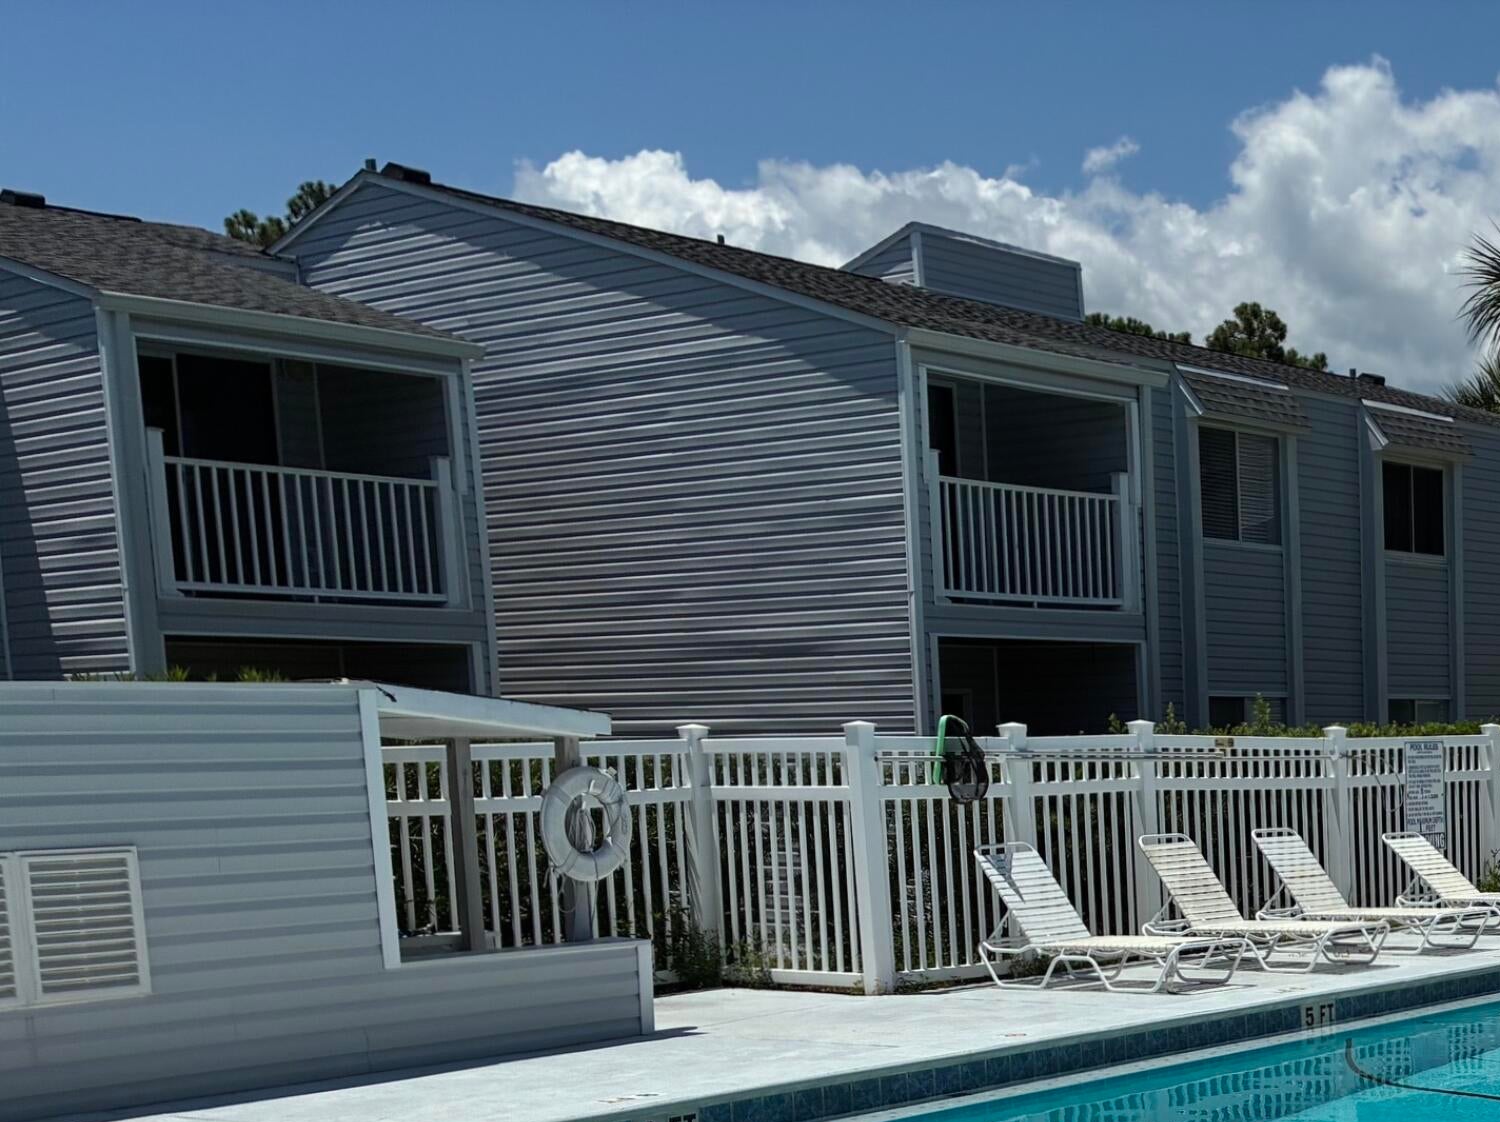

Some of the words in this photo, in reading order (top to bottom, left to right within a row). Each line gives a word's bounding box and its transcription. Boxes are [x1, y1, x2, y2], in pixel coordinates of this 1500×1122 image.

[1409, 743, 1422, 751] POOL
[1305, 1006, 1315, 1026] 5
[1319, 1003, 1334, 1024] FT
